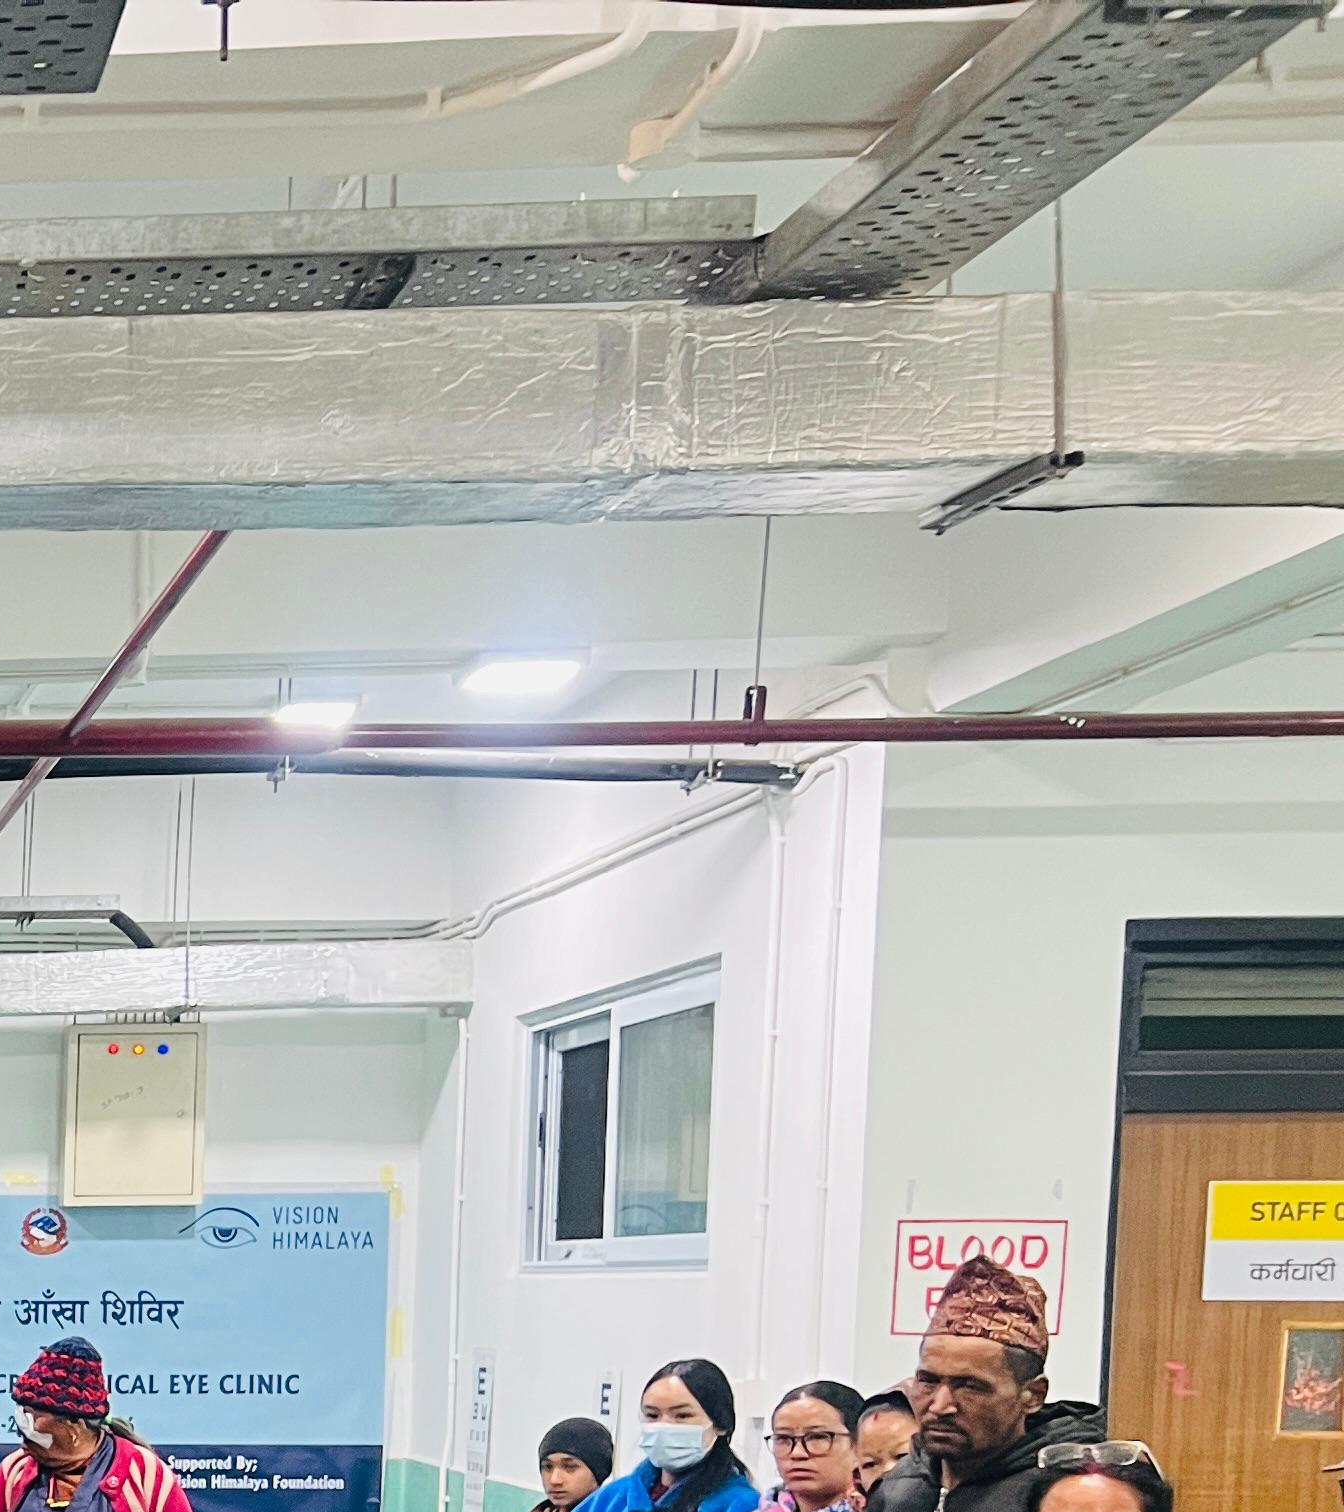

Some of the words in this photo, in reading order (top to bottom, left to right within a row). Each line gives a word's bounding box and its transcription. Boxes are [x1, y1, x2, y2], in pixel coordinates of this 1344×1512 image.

[272, 1206, 339, 1225] VISION
[1250, 1201, 1327, 1222] STAFF
[272, 1231, 374, 1250] HIMALAYA
[907, 1235, 1049, 1271] BLOOD
[1249, 1256, 1336, 1282] कर्मचारी
[14, 1288, 90, 1330] आँखा
[100, 1289, 185, 1330] शिविर
[169, 1374, 210, 1395] EYE
[219, 1374, 300, 1395] CLINIC
[167, 1454, 232, 1473] Supported
[176, 1473, 207, 1489] ision
[211, 1474, 269, 1492] Himalaya
[272, 1474, 345, 1490] Foundation
